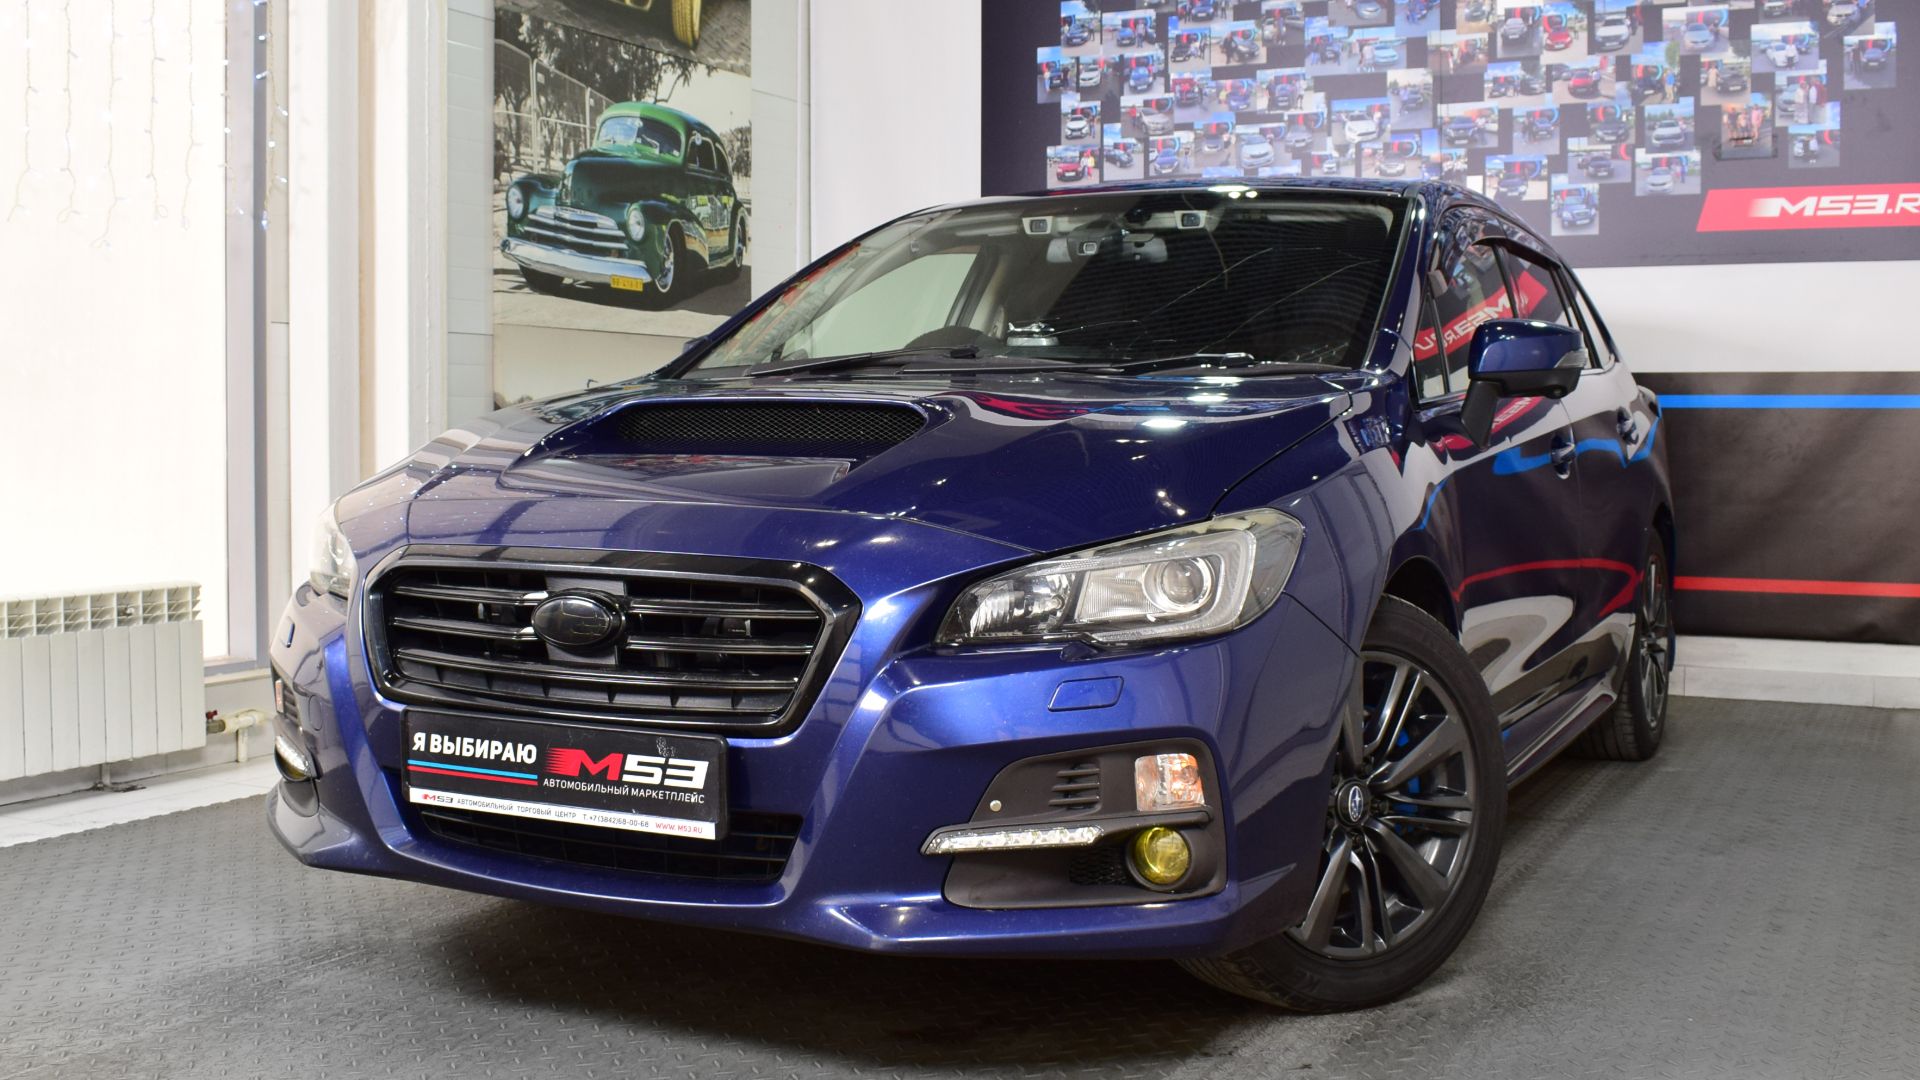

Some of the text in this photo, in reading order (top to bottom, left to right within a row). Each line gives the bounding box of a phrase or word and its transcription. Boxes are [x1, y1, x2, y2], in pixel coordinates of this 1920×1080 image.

[412, 732, 537, 764] Я ВЫБИРАЮ
[543, 747, 709, 789] M53
[543, 778, 705, 804] АВТОМОБИЛЬНЫЙ МАРКЕТПЛЕЙС
[422, 794, 454, 803] M53
[457, 799, 514, 811] АВТОМОБИЛЬНЫЙ
[517, 806, 552, 816] ТОРГОВЫЙ
[555, 810, 577, 819] ЦЕНТР
